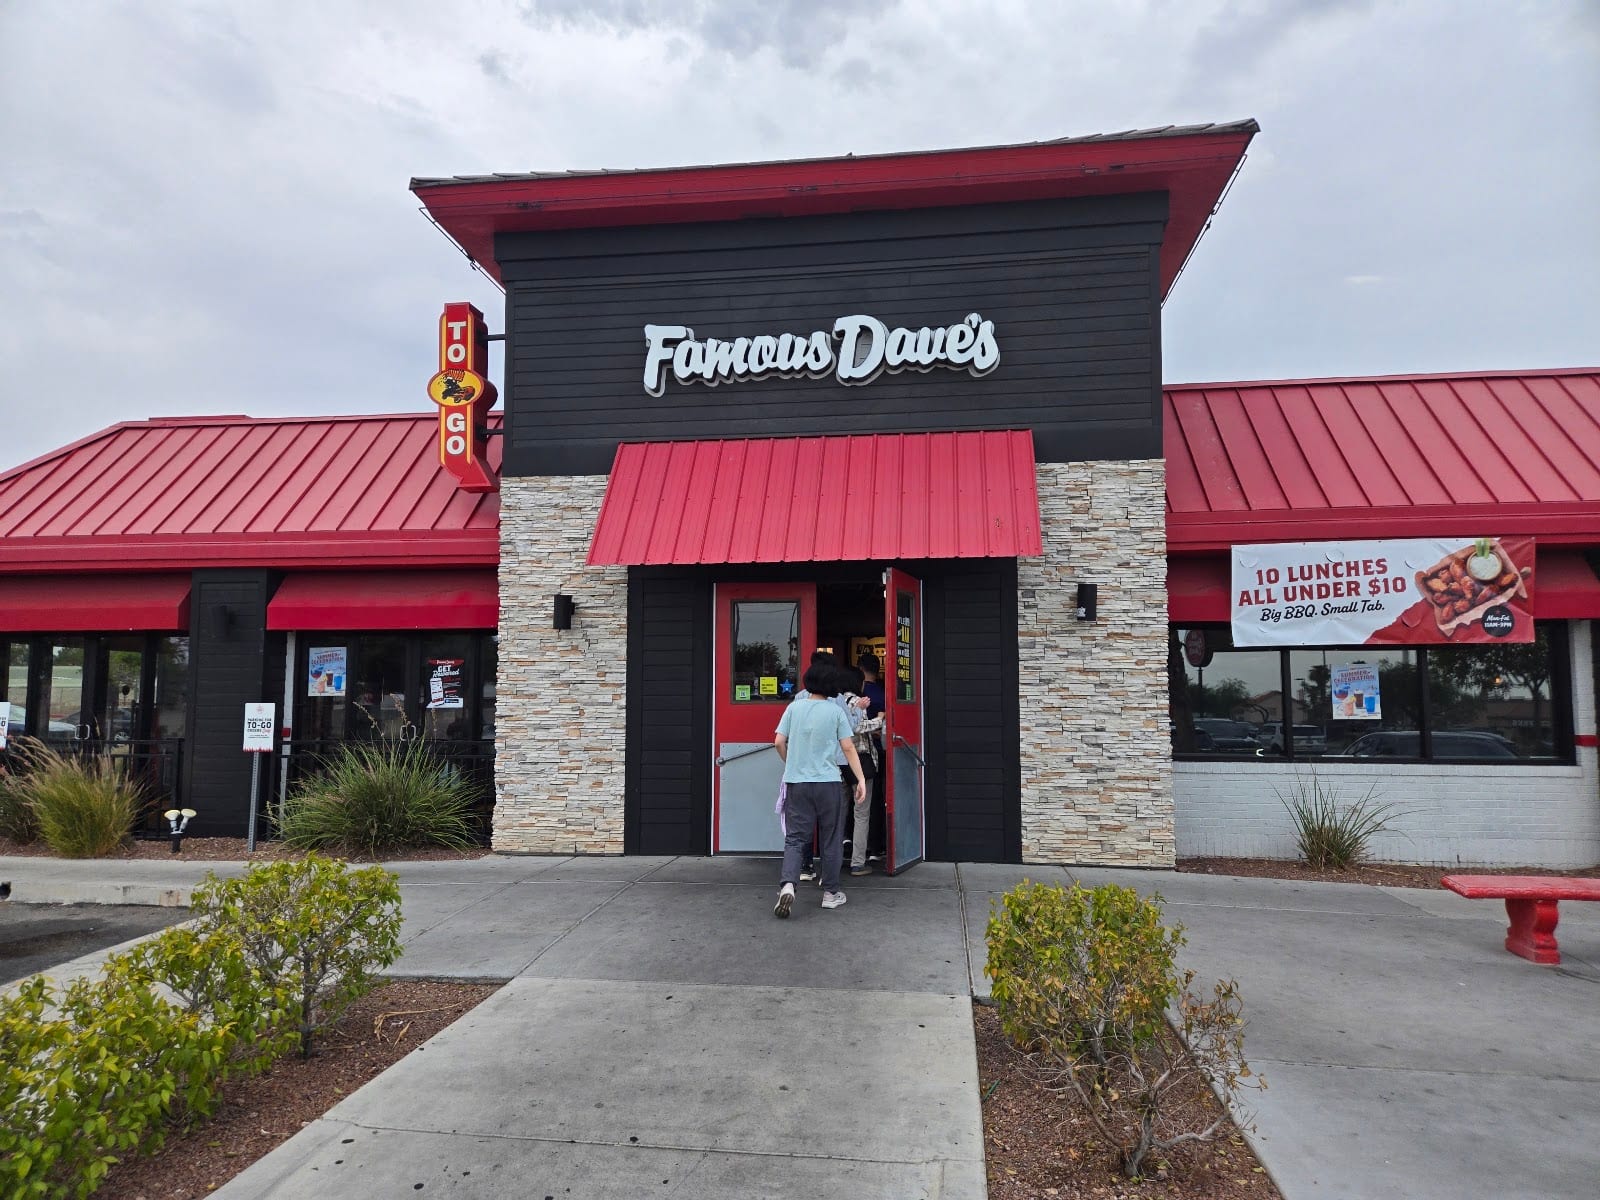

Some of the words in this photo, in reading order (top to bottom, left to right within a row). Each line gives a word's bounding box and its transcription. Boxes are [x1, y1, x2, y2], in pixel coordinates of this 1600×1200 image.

[447, 321, 467, 363] TO
[643, 324, 834, 397] Famous
[832, 312, 1000, 386] Dave's
[446, 412, 466, 456] GO
[1256, 568, 1280, 586] 10
[1287, 558, 1389, 583] LUNCHES
[1238, 588, 1278, 607] ALL
[1283, 580, 1362, 602] UNDER
[1368, 576, 1407, 597] $10
[1260, 608, 1282, 623] Big
[1283, 604, 1318, 620] BBQ.
[1321, 602, 1358, 616] Small
[1361, 599, 1385, 614] Tab.
[437, 664, 452, 673] GET
[247, 721, 272, 729] TO-GO
